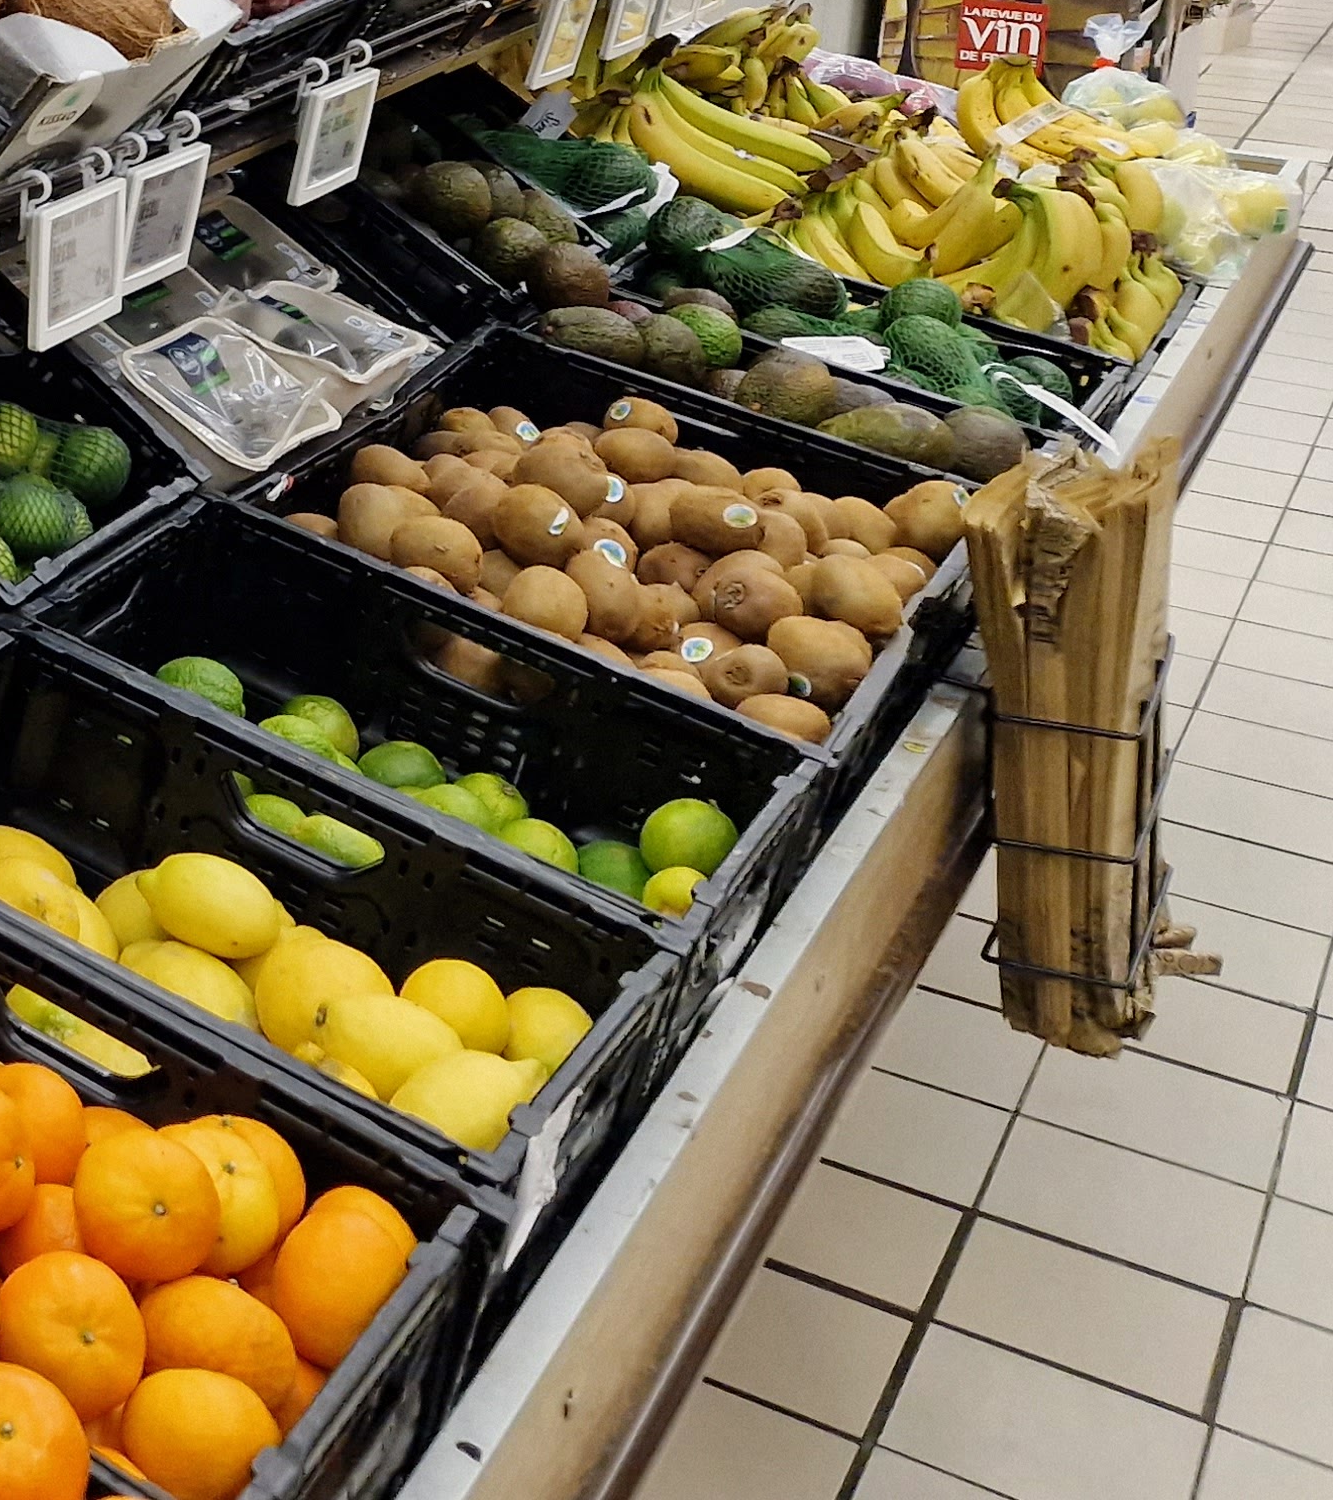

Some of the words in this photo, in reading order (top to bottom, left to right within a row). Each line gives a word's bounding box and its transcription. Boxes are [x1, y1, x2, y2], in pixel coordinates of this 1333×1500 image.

[963, 6, 983, 17] LA
[983, 7, 1023, 21] REVUE
[1023, 11, 1043, 23] DU
[959, 50, 978, 62] DE
